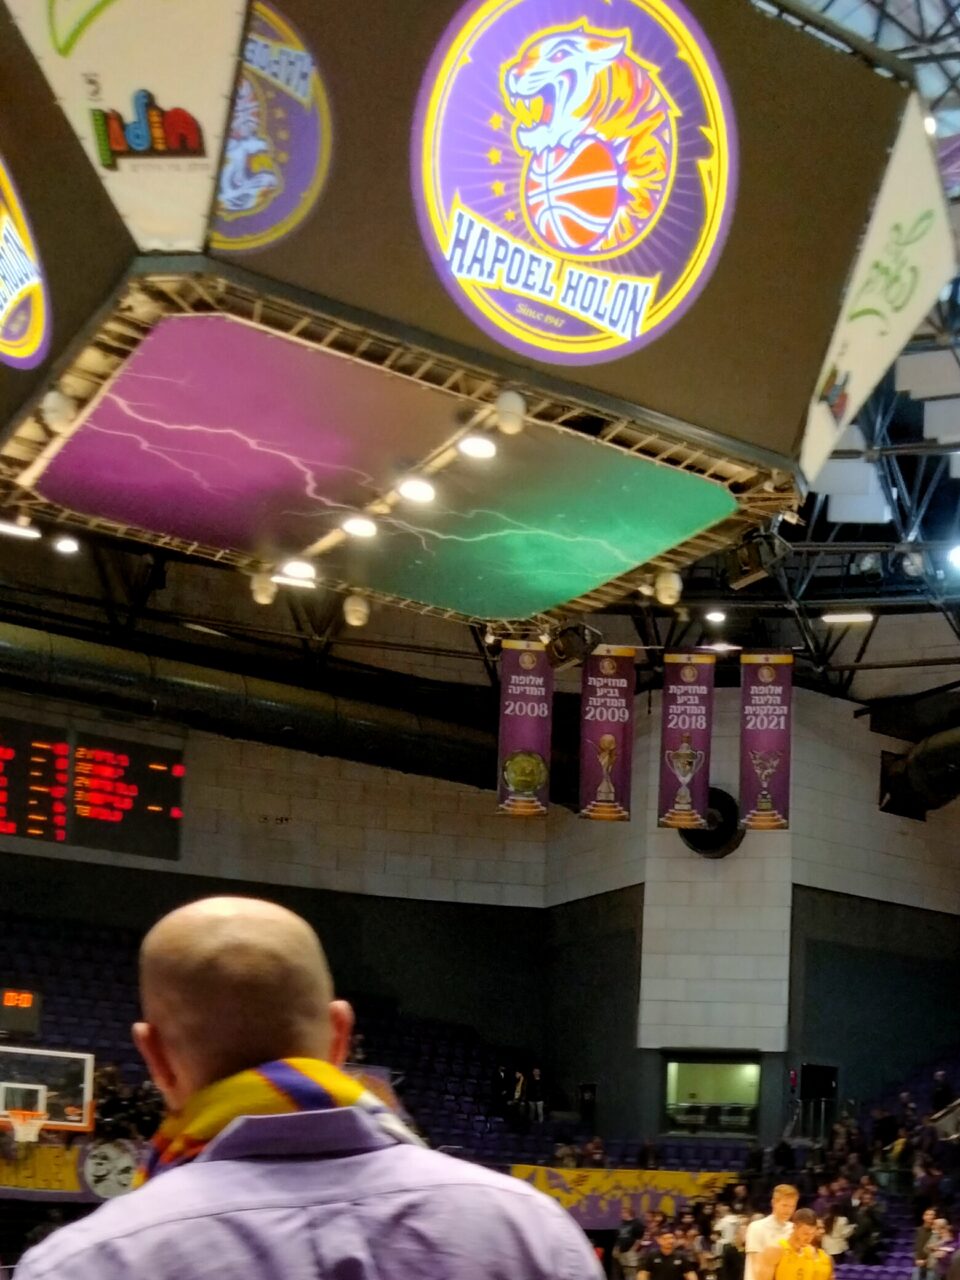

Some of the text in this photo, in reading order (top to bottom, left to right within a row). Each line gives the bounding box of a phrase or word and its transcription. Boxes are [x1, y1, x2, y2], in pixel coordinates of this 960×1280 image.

[451, 211, 650, 338] HAPOEL HOLON
[510, 675, 544, 686] אלופת
[587, 676, 628, 688] מחזיקת
[508, 685, 546, 696] המדינה
[668, 685, 708, 695] מחזיקת
[750, 685, 783, 695] אלופת
[588, 697, 626, 707] המדינה
[504, 700, 549, 717] 2008
[584, 706, 630, 722] 2009
[669, 705, 706, 715] המדינה
[667, 714, 707, 730] 2018
[745, 715, 786, 730] 2021
